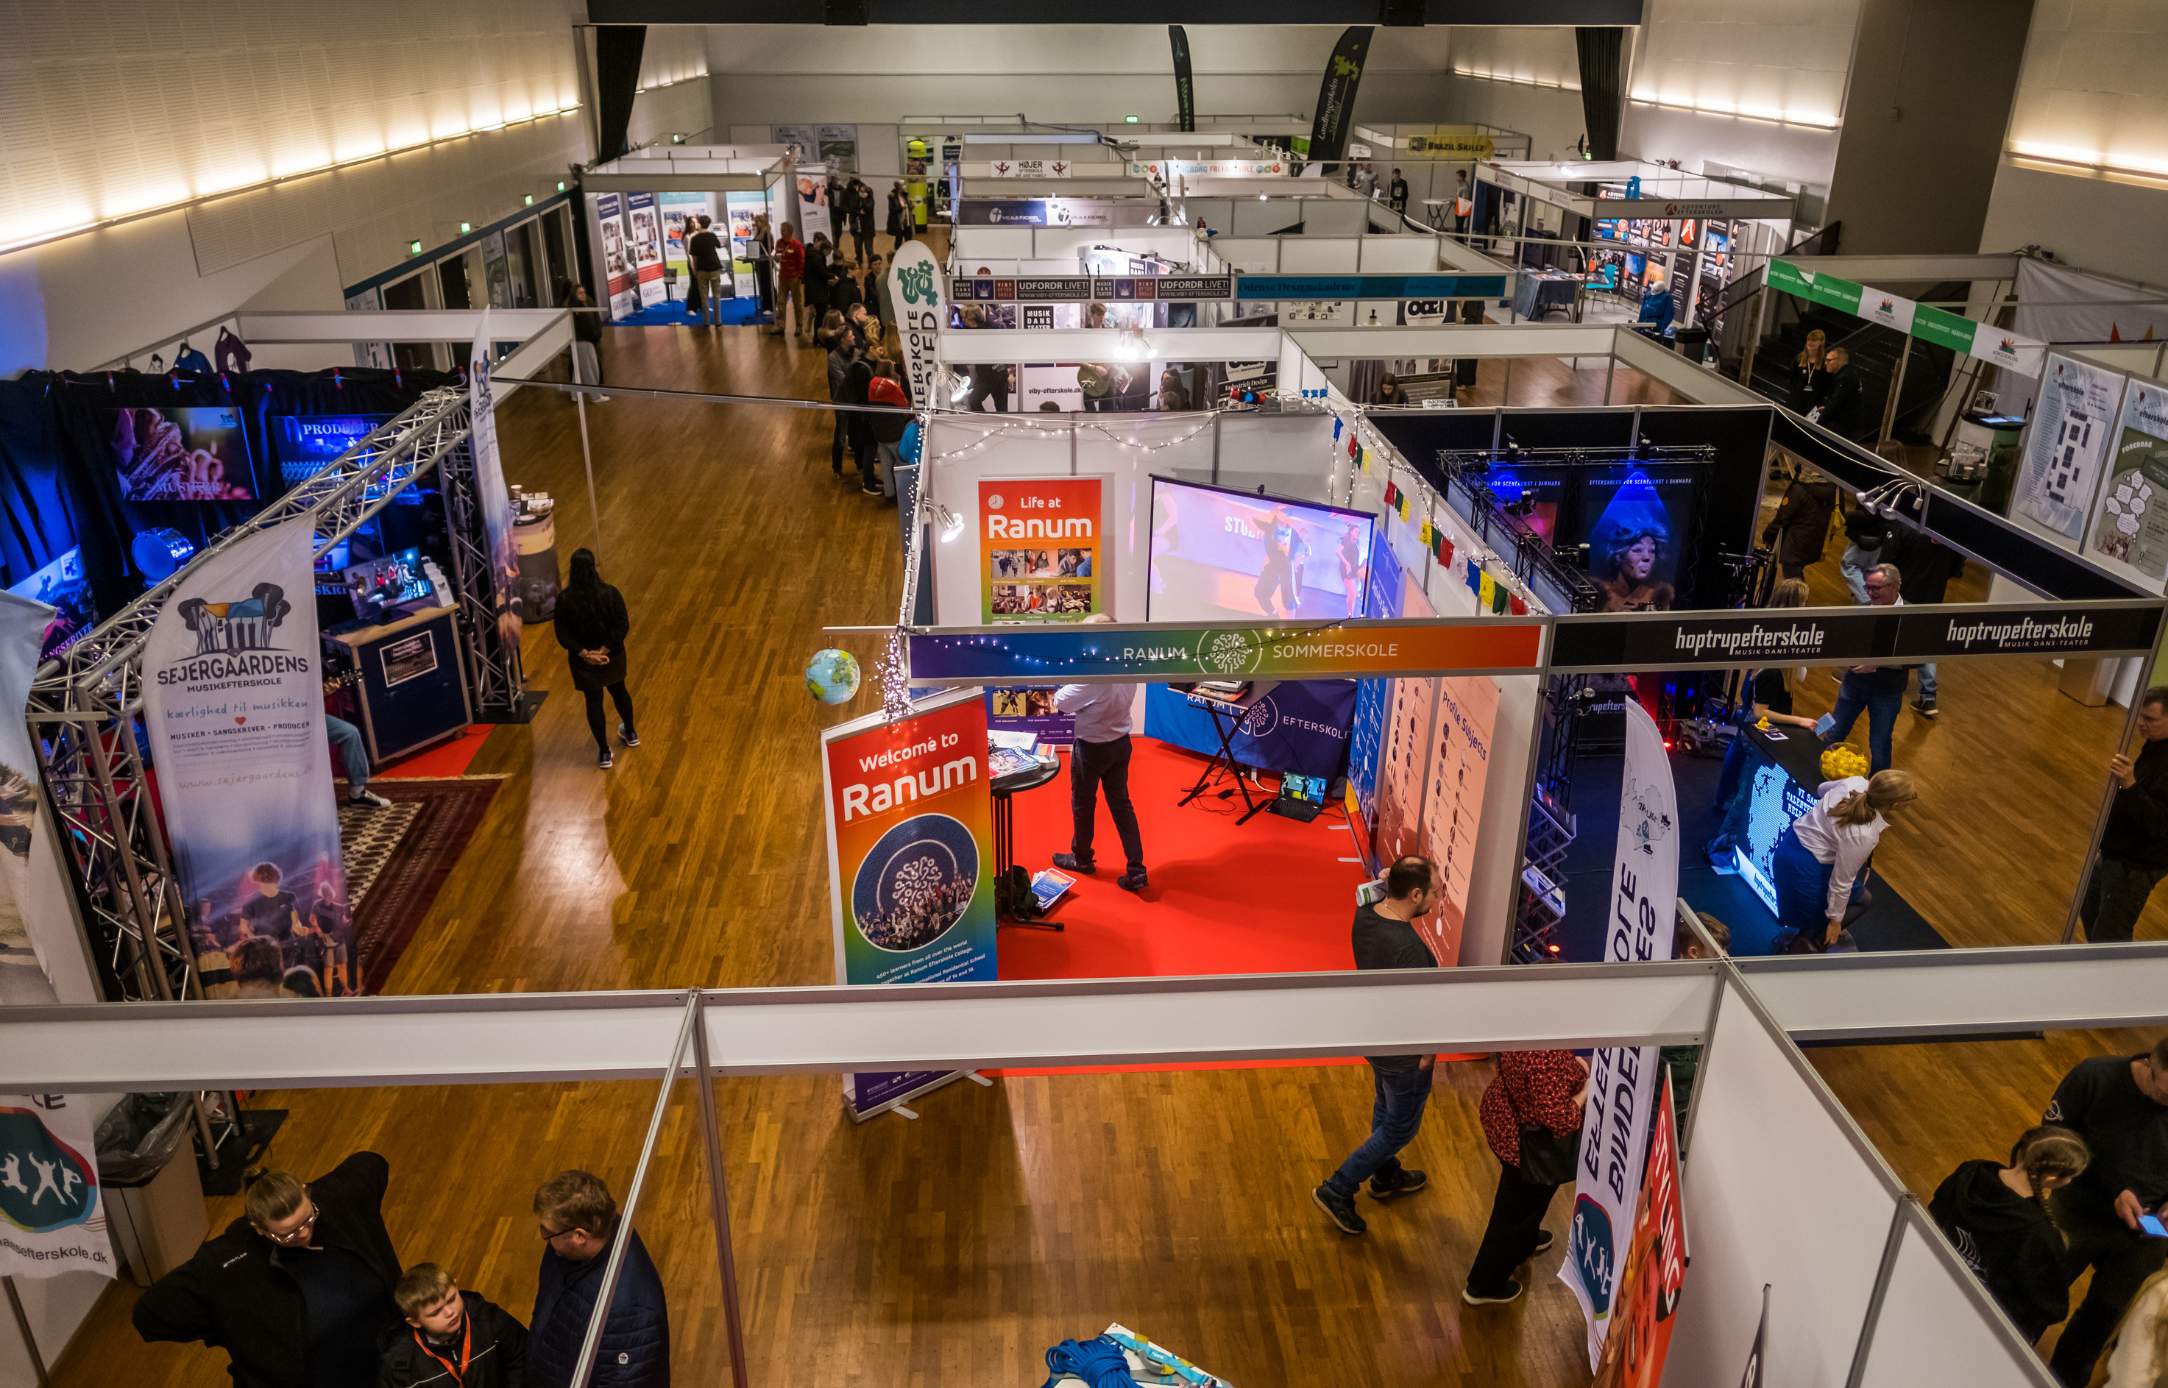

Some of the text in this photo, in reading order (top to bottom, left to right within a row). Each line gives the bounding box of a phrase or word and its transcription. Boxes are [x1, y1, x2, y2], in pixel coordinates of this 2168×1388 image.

[1020, 282, 1088, 290] UDFORDR LIVET!
[1160, 280, 1229, 289] UDFORDR LIVET!
[1021, 497, 1061, 508] Life at
[988, 515, 1092, 538] Ranum
[1675, 623, 1824, 656] hoptrupefterskole
[1947, 616, 2093, 648] hoptrupefterskole
[1123, 643, 1399, 660] RANUM SOMMERSKOLE
[157, 655, 308, 685] SEJERGAARDENS
[187, 677, 282, 693] MUSIKEFTERSKOLE
[167, 698, 308, 719] kærlighed til musikken
[170, 721, 310, 740] MUSIKER SANGSKRIVER PRODUCER
[1442, 691, 1487, 760] Profile Subjects
[859, 733, 958, 772] Welcome to
[843, 756, 976, 821] Ranum
[953, 940, 967, 950] world
[1655, 1110, 1679, 1314] STYLING
